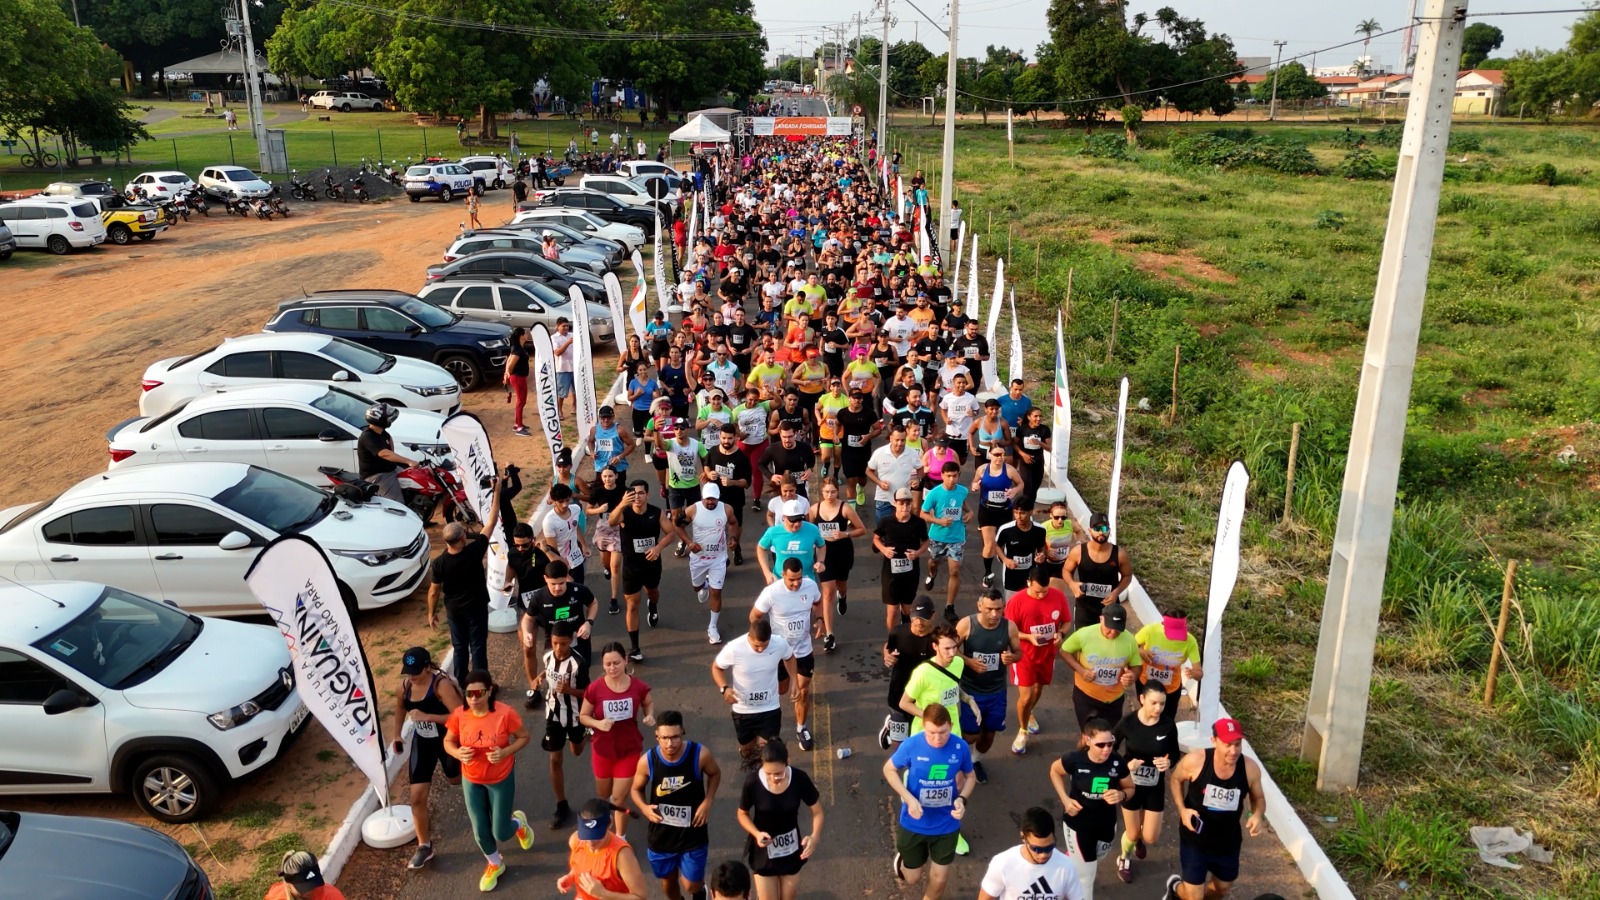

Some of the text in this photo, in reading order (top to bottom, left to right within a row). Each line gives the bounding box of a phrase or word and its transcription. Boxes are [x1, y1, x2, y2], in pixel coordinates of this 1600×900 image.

[895, 559, 910, 567] 1192
[305, 578, 326, 611] PARA
[1091, 585, 1107, 593] 0907
[788, 620, 804, 631] 0707
[1098, 668, 1117, 678] 0954
[1150, 669, 1169, 679] 1458
[750, 691, 768, 700] 1887
[302, 663, 366, 745] PREFEITURA
[608, 701, 629, 712] 0332
[926, 788, 948, 799] 1256
[1212, 788, 1234, 801] 1649
[664, 806, 686, 818] 0675
[773, 832, 794, 848] 0081
